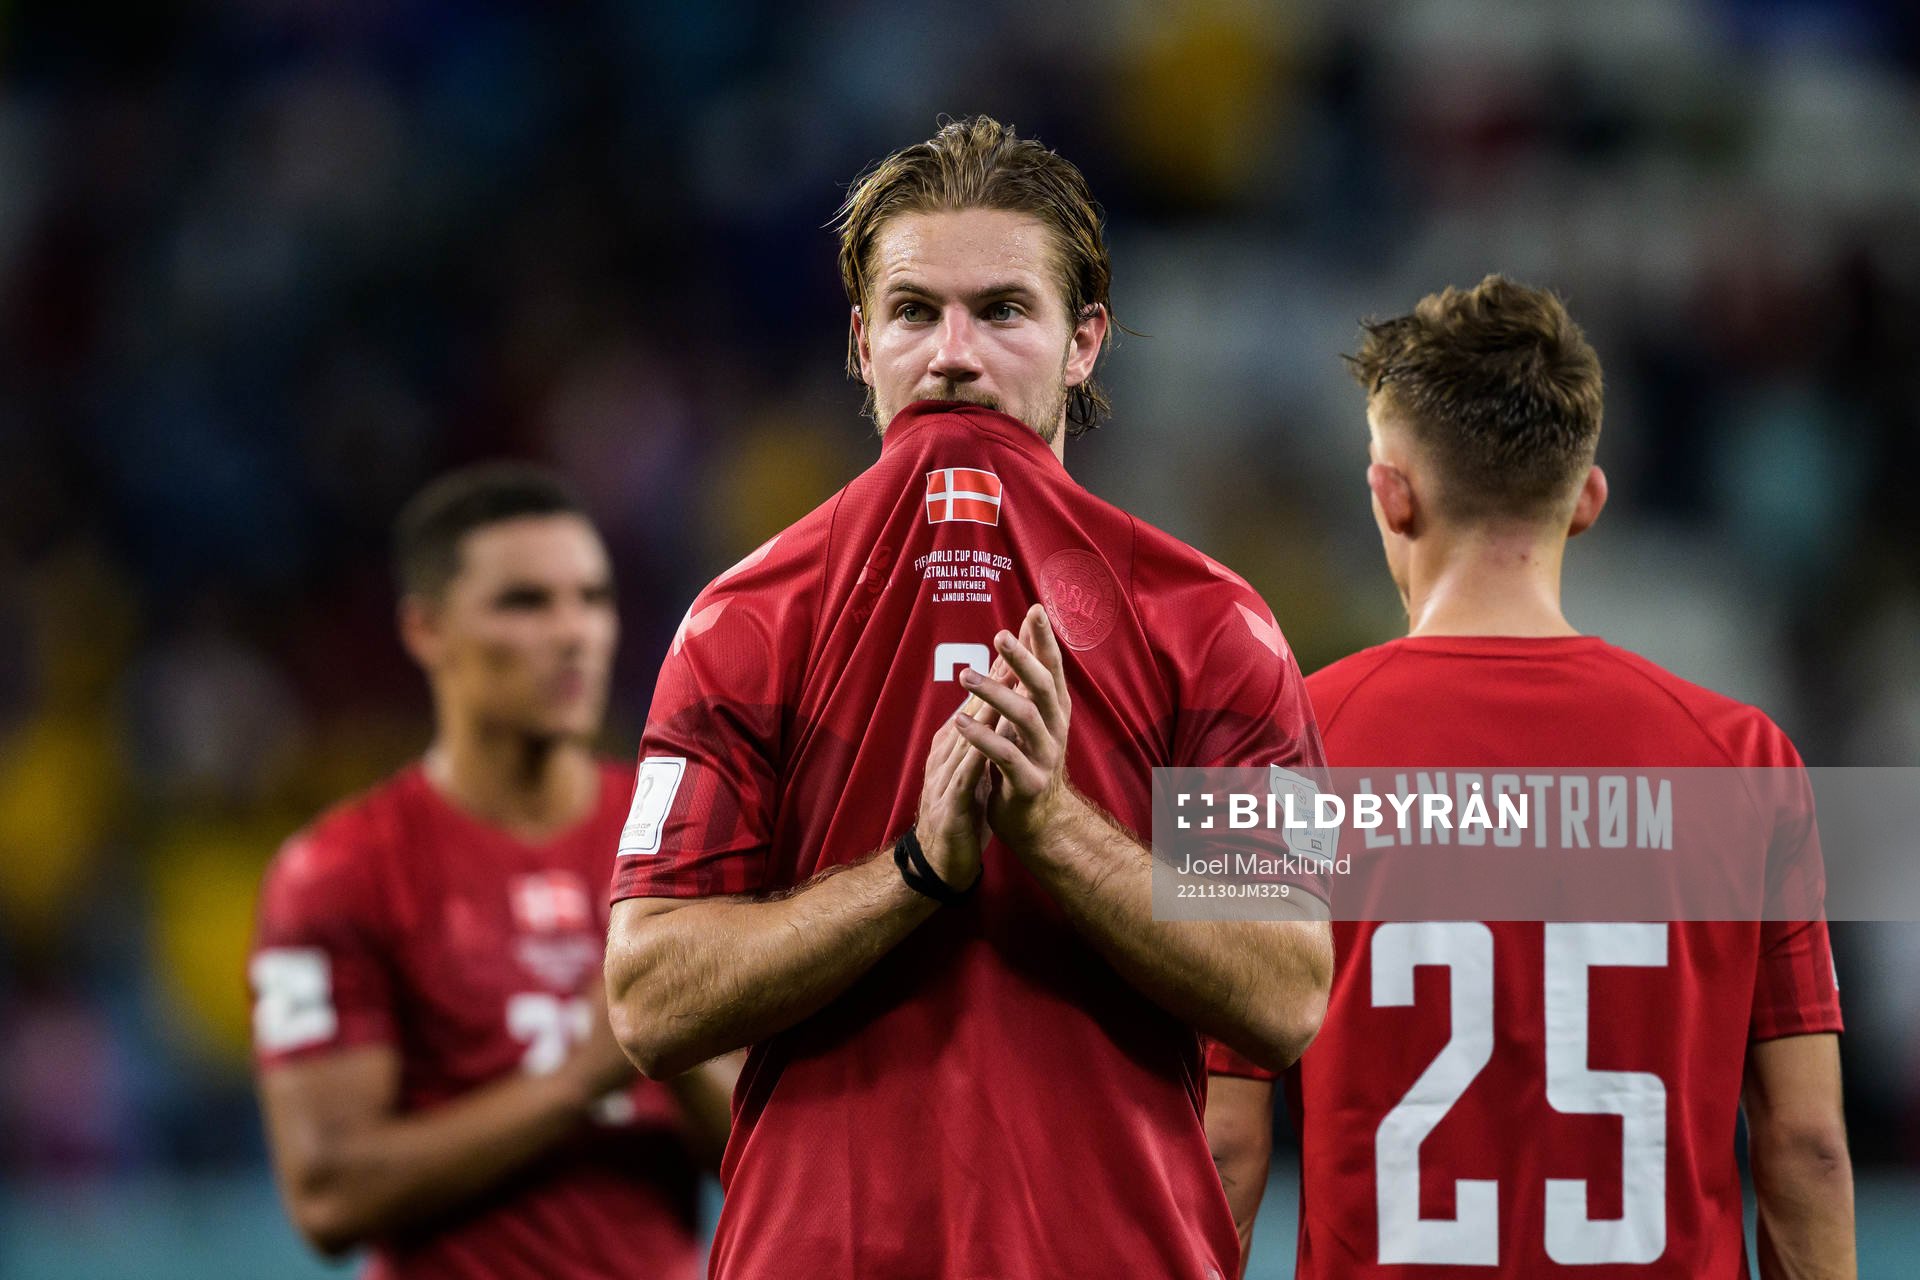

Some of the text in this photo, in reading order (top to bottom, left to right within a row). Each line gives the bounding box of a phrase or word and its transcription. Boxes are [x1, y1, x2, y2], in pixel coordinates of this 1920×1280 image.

[955, 550, 970, 562] CUP
[992, 554, 1012, 570] 2022
[937, 580, 986, 590] 30TH NOVEMBER
[932, 592, 992, 603] AL JANOUB STADIUM
[1371, 920, 1669, 1267] 25
